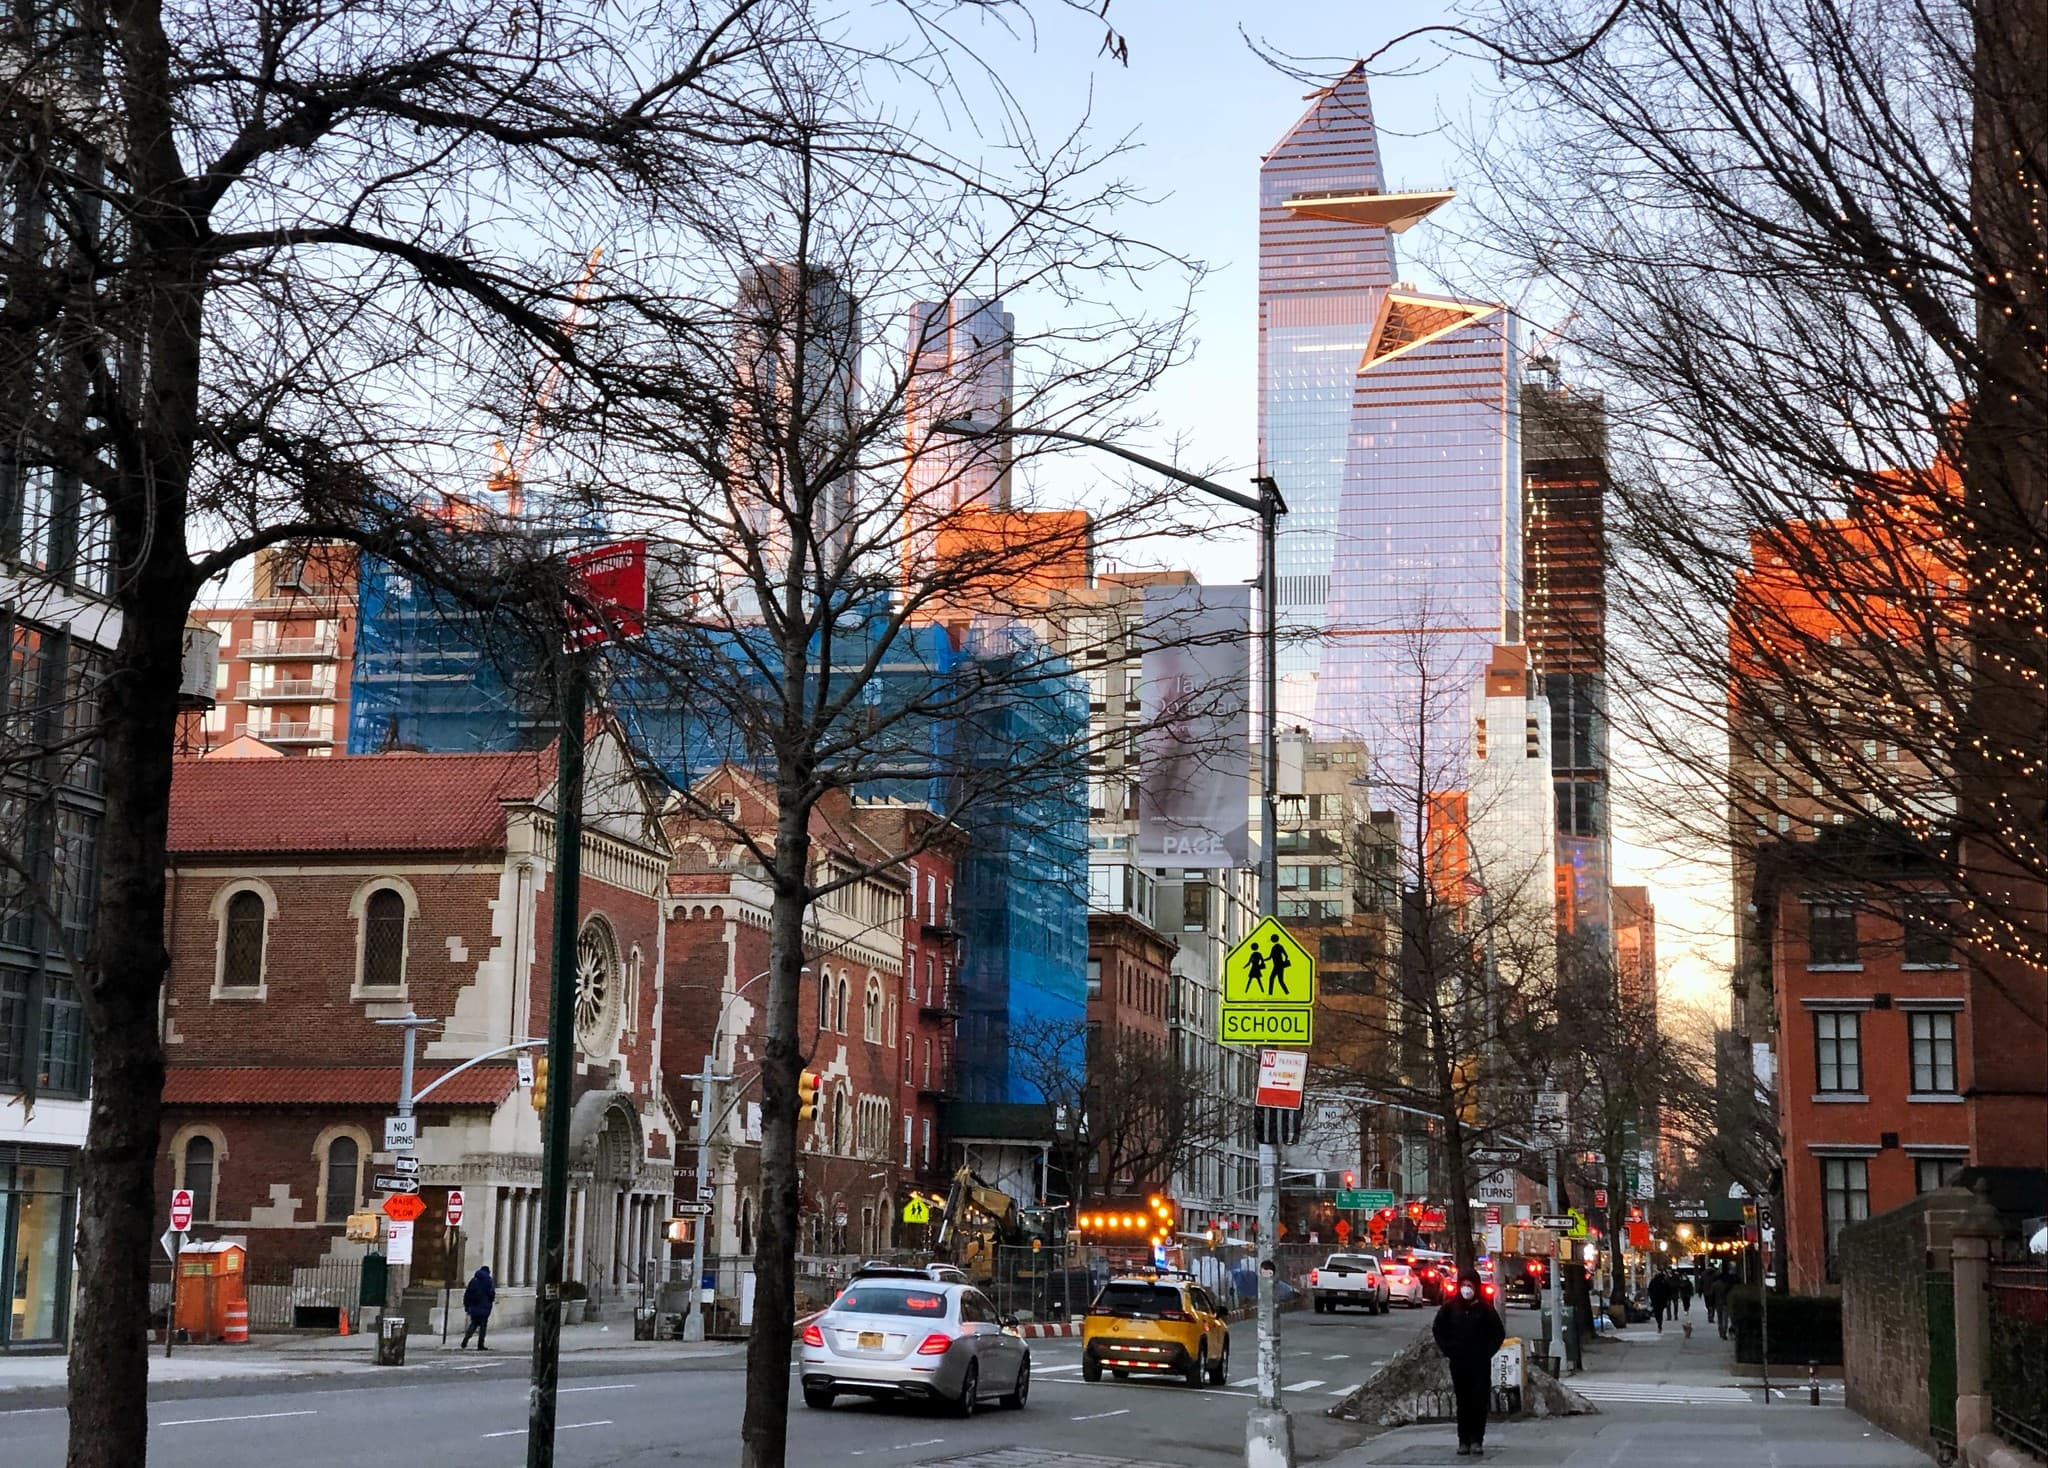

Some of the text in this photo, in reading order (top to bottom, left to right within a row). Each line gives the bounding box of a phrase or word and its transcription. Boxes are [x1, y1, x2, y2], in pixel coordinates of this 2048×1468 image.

[1227, 1016, 1304, 1033] SCHOOL
[1263, 1052, 1276, 1066] NO
[1325, 1111, 1337, 1119] NO
[394, 1122, 407, 1132] NO
[387, 1136, 413, 1145] TURNS
[1488, 1172, 1504, 1184] NO
[1480, 1188, 1512, 1199] TURNS
[1640, 1184, 1652, 1193] 25
[393, 1198, 413, 1206] RAISE
